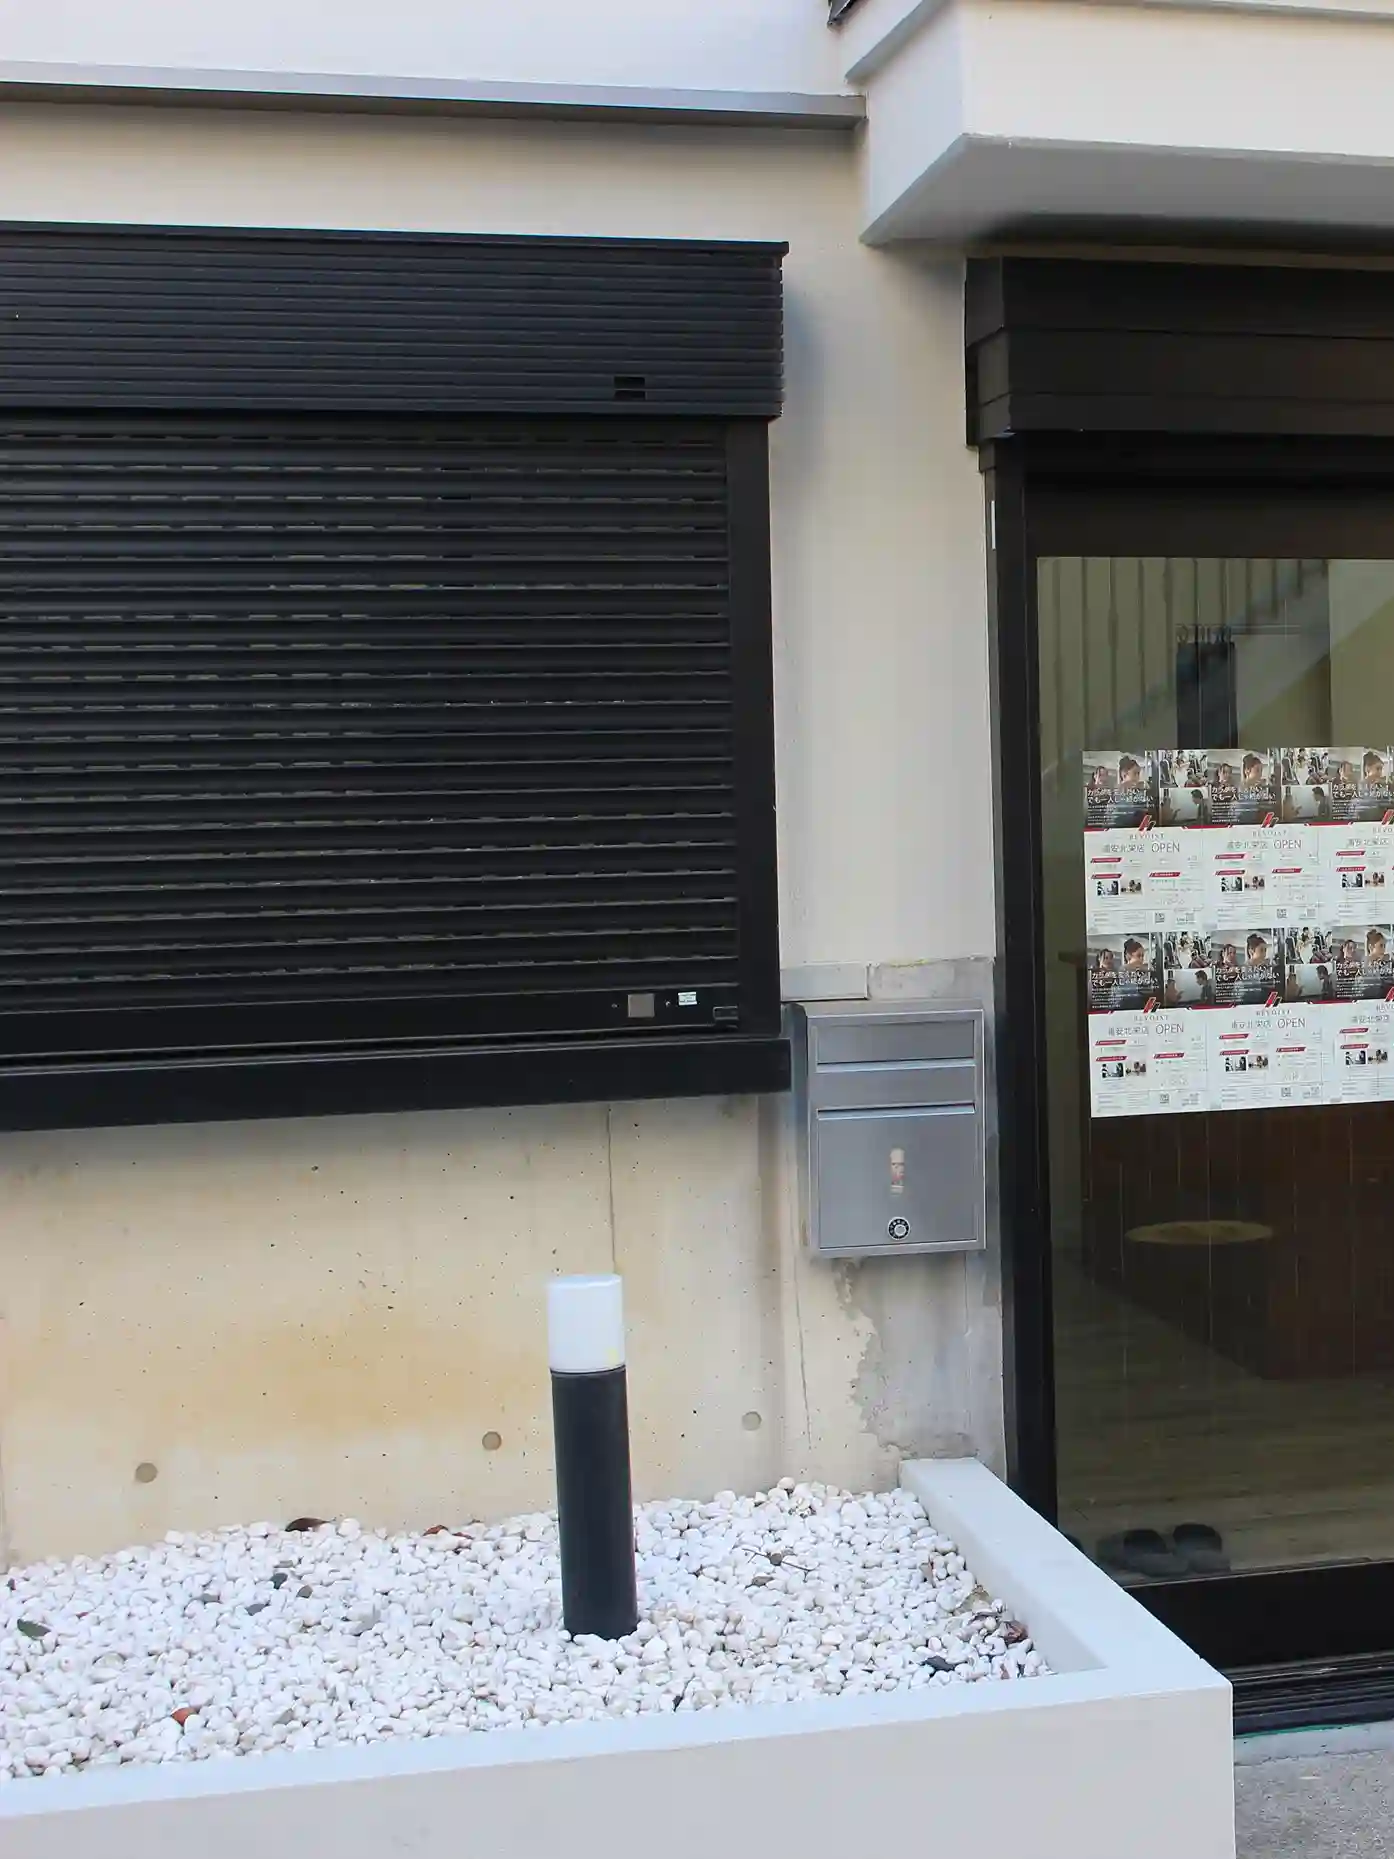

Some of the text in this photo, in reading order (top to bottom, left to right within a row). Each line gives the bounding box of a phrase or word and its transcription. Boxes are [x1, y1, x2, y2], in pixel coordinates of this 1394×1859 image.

[1152, 841, 1180, 853] OPEN
[1274, 839, 1302, 849] OPEN
[1156, 1022, 1184, 1034] OPEN
[1277, 1018, 1306, 1029] OPEN
